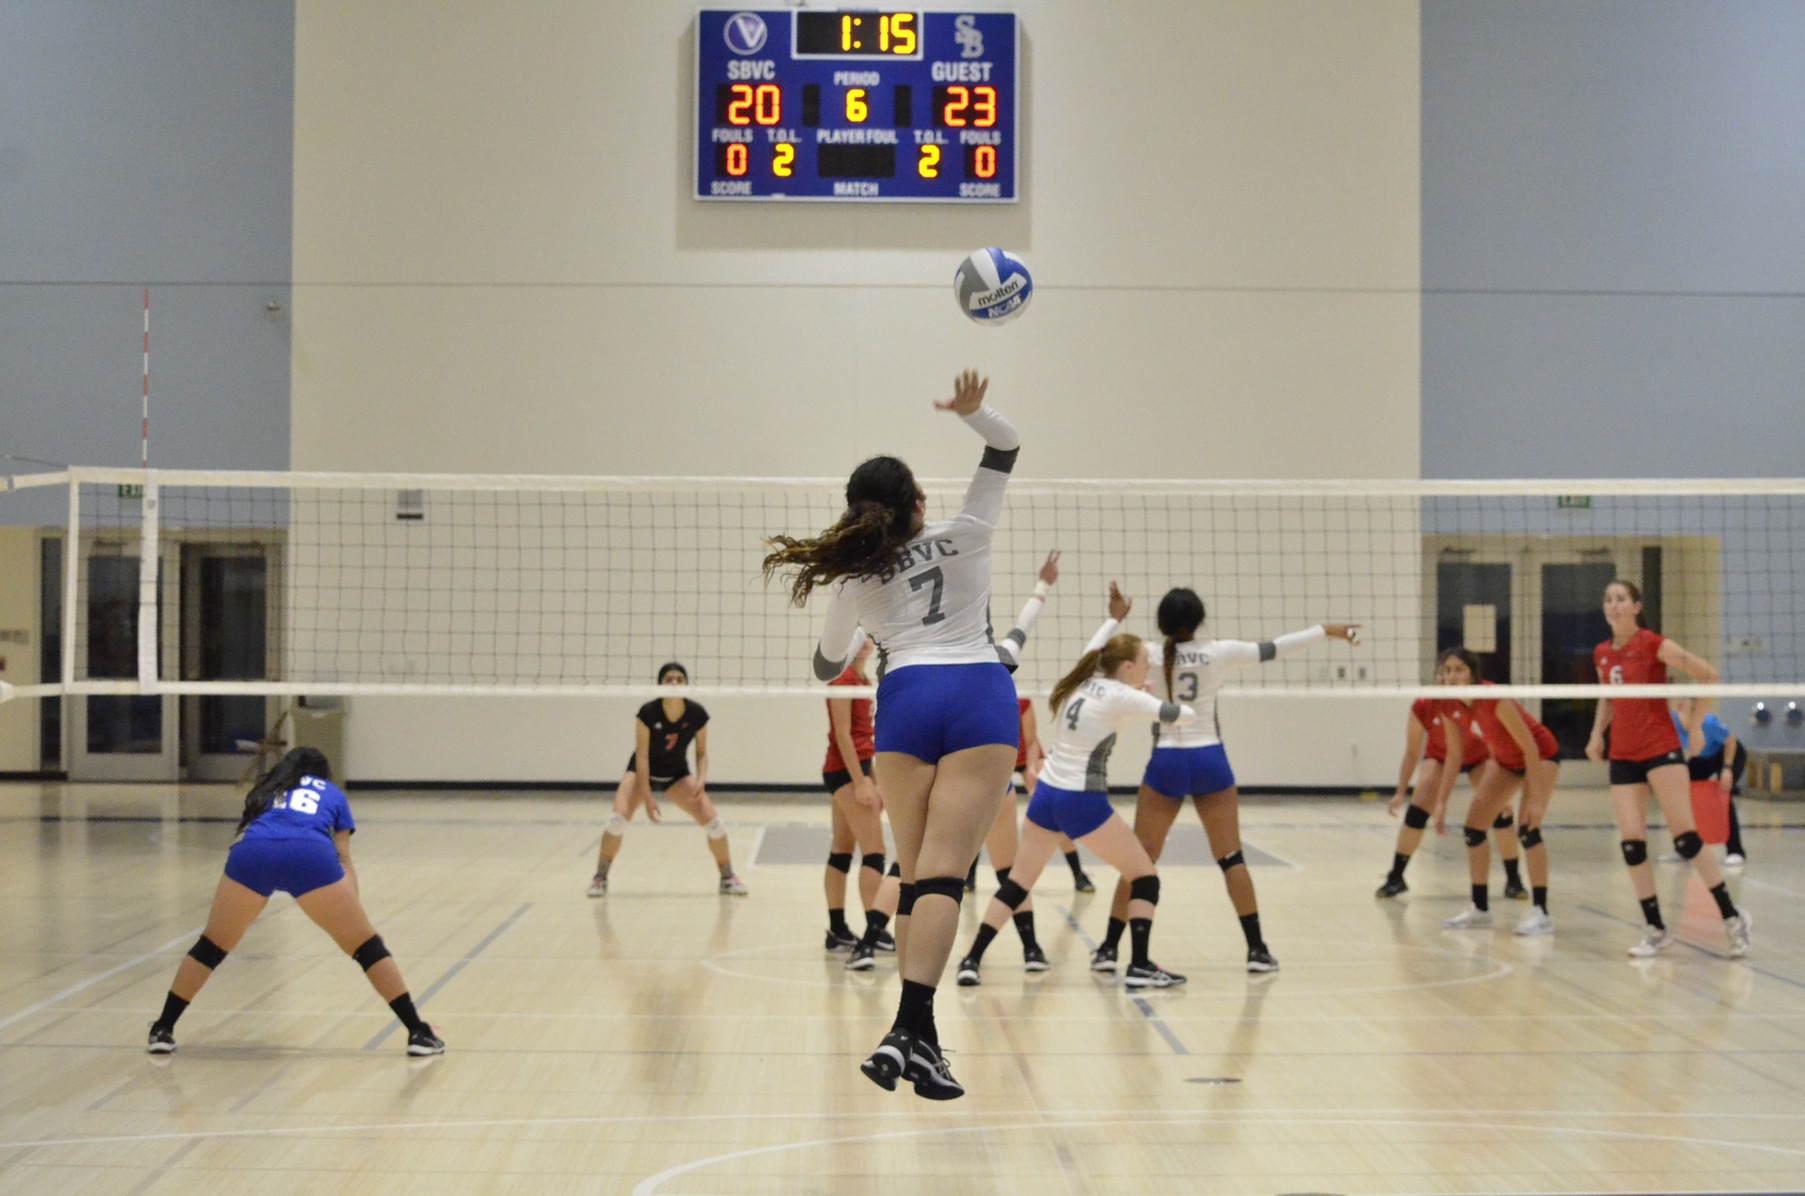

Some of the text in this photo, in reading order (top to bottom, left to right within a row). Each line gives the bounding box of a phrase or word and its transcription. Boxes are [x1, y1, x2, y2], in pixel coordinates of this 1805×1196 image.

[841, 13, 917, 55] 1:15
[727, 60, 776, 80] SBVC
[833, 71, 880, 86] PERIOD
[931, 61, 993, 82] GUEST
[728, 84, 781, 126] 20
[845, 88, 868, 123] 6
[943, 86, 997, 128] 23
[711, 128, 754, 143] FOULS
[816, 128, 899, 144] PLAYER FOUL
[959, 130, 1002, 145] FOULS
[726, 143, 748, 177] 0
[772, 143, 795, 177] 2
[918, 144, 941, 178] 2
[974, 145, 997, 179] 0
[710, 181, 752, 196] SCORE
[833, 182, 879, 197] MATCH
[959, 183, 1001, 198] SCORE
[978, 280, 1019, 306] molten
[908, 565, 946, 627] 7
[1178, 671, 1199, 702] 3
[1066, 697, 1085, 731] 4
[665, 732, 680, 751] 7
